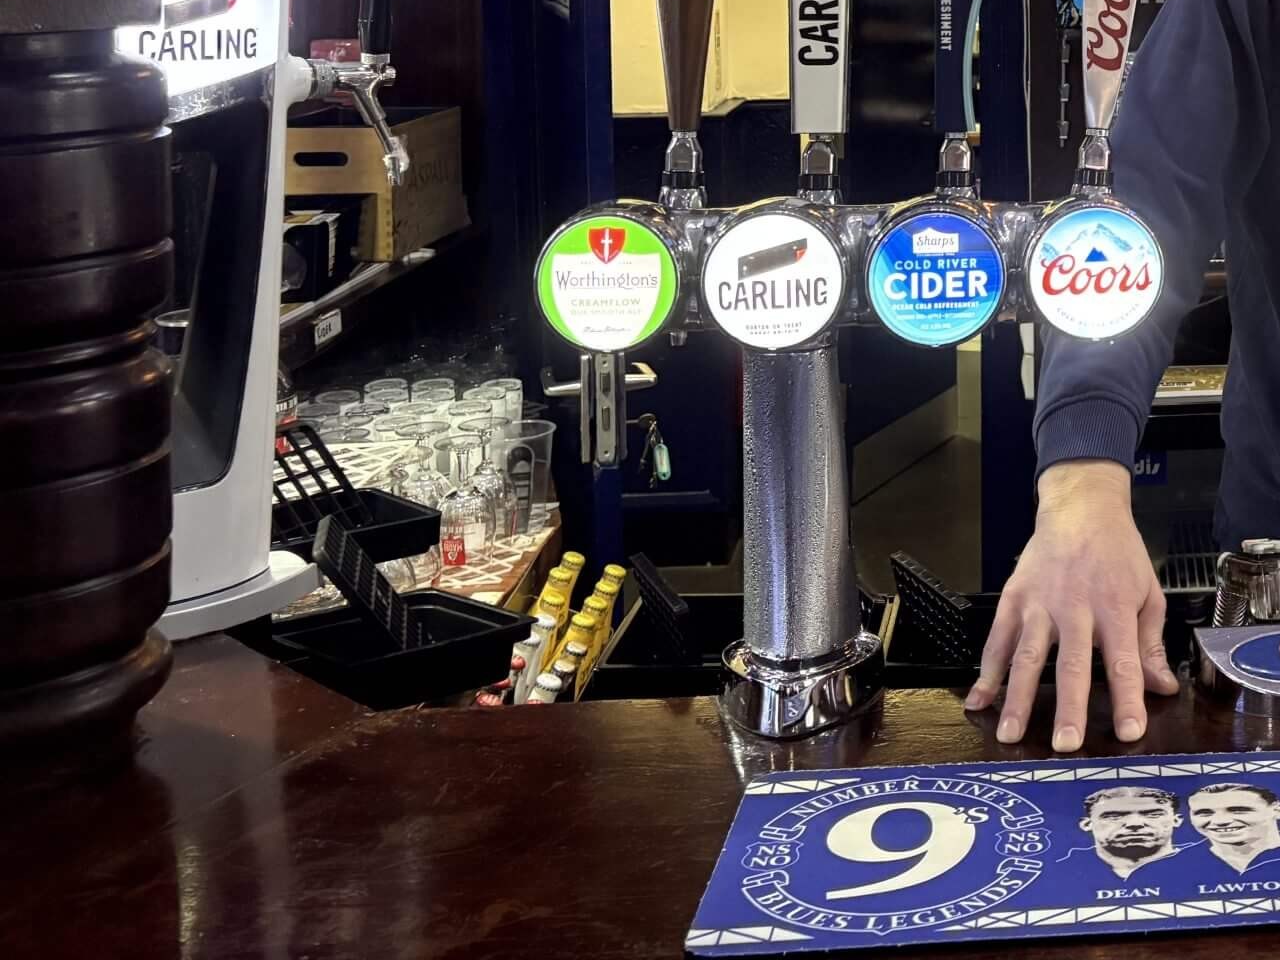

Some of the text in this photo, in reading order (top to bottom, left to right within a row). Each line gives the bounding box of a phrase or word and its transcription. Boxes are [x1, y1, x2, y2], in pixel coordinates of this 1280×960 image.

[139, 28, 257, 61] CARLING
[895, 258, 977, 270] COLD RIVER
[883, 270, 988, 300] CIDER
[1040, 254, 1153, 296] Coors
[718, 277, 828, 311] CARLING
[791, 779, 1022, 819] NUMBER NINE'S
[1008, 831, 1041, 841] NS
[758, 845, 791, 855] NS
[1005, 843, 1043, 854] NO
[750, 855, 791, 866] NO
[757, 877, 1023, 929] BLUES LEGENDS
[1096, 887, 1160, 900] DEAN
